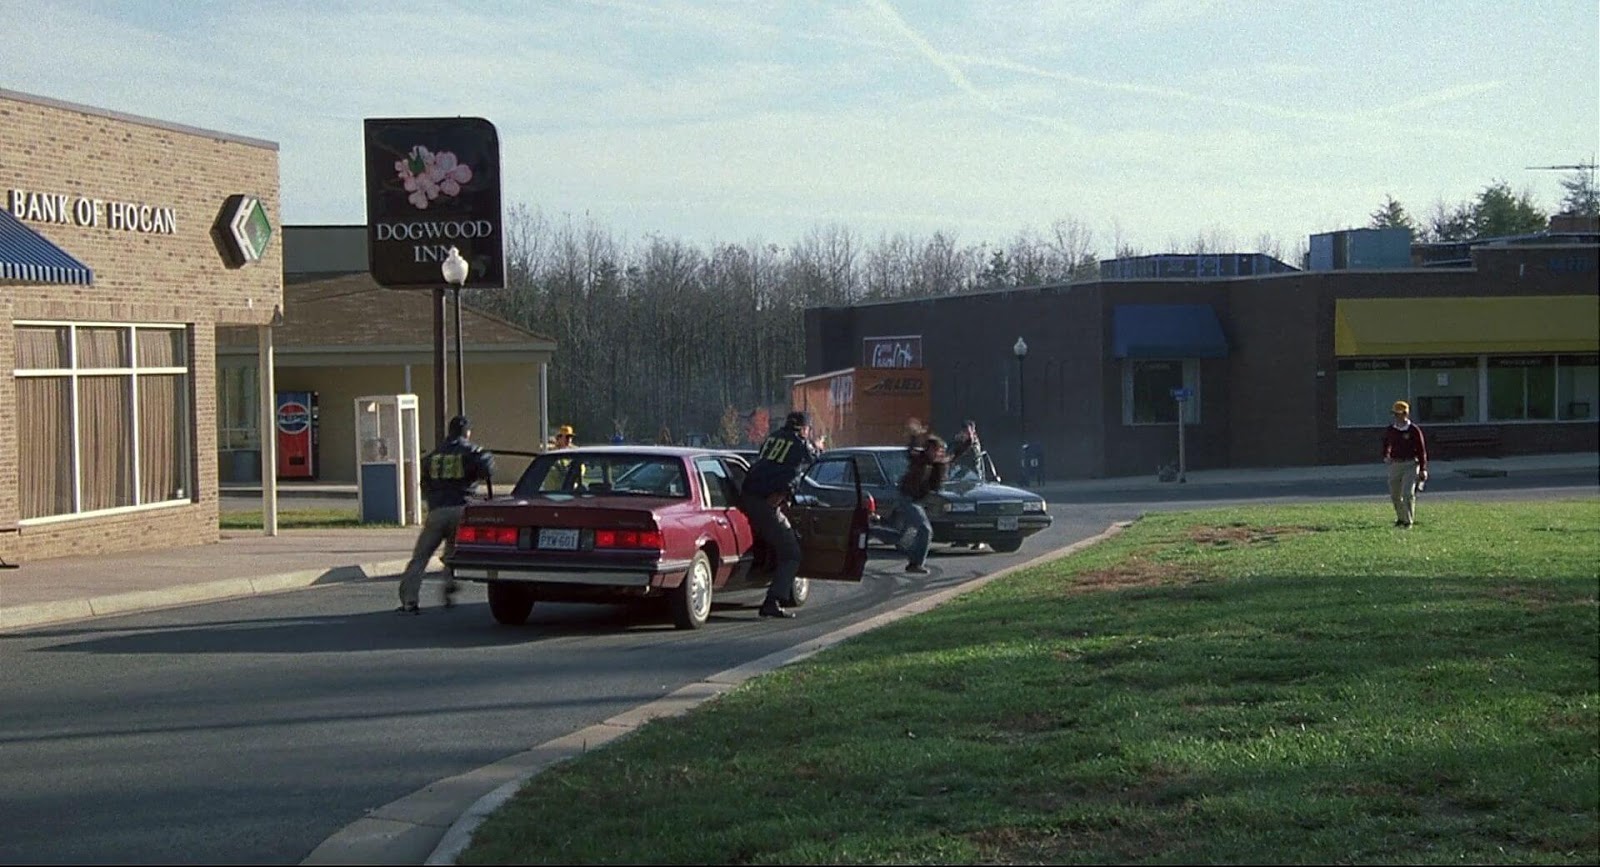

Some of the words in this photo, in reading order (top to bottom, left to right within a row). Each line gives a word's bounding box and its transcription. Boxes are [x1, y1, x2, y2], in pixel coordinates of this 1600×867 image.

[11, 189, 70, 224] BANK
[76, 197, 103, 228] OF
[109, 201, 177, 235] HOGAN
[376, 221, 493, 241] DOGWOOD
[760, 437, 793, 463] FBI
